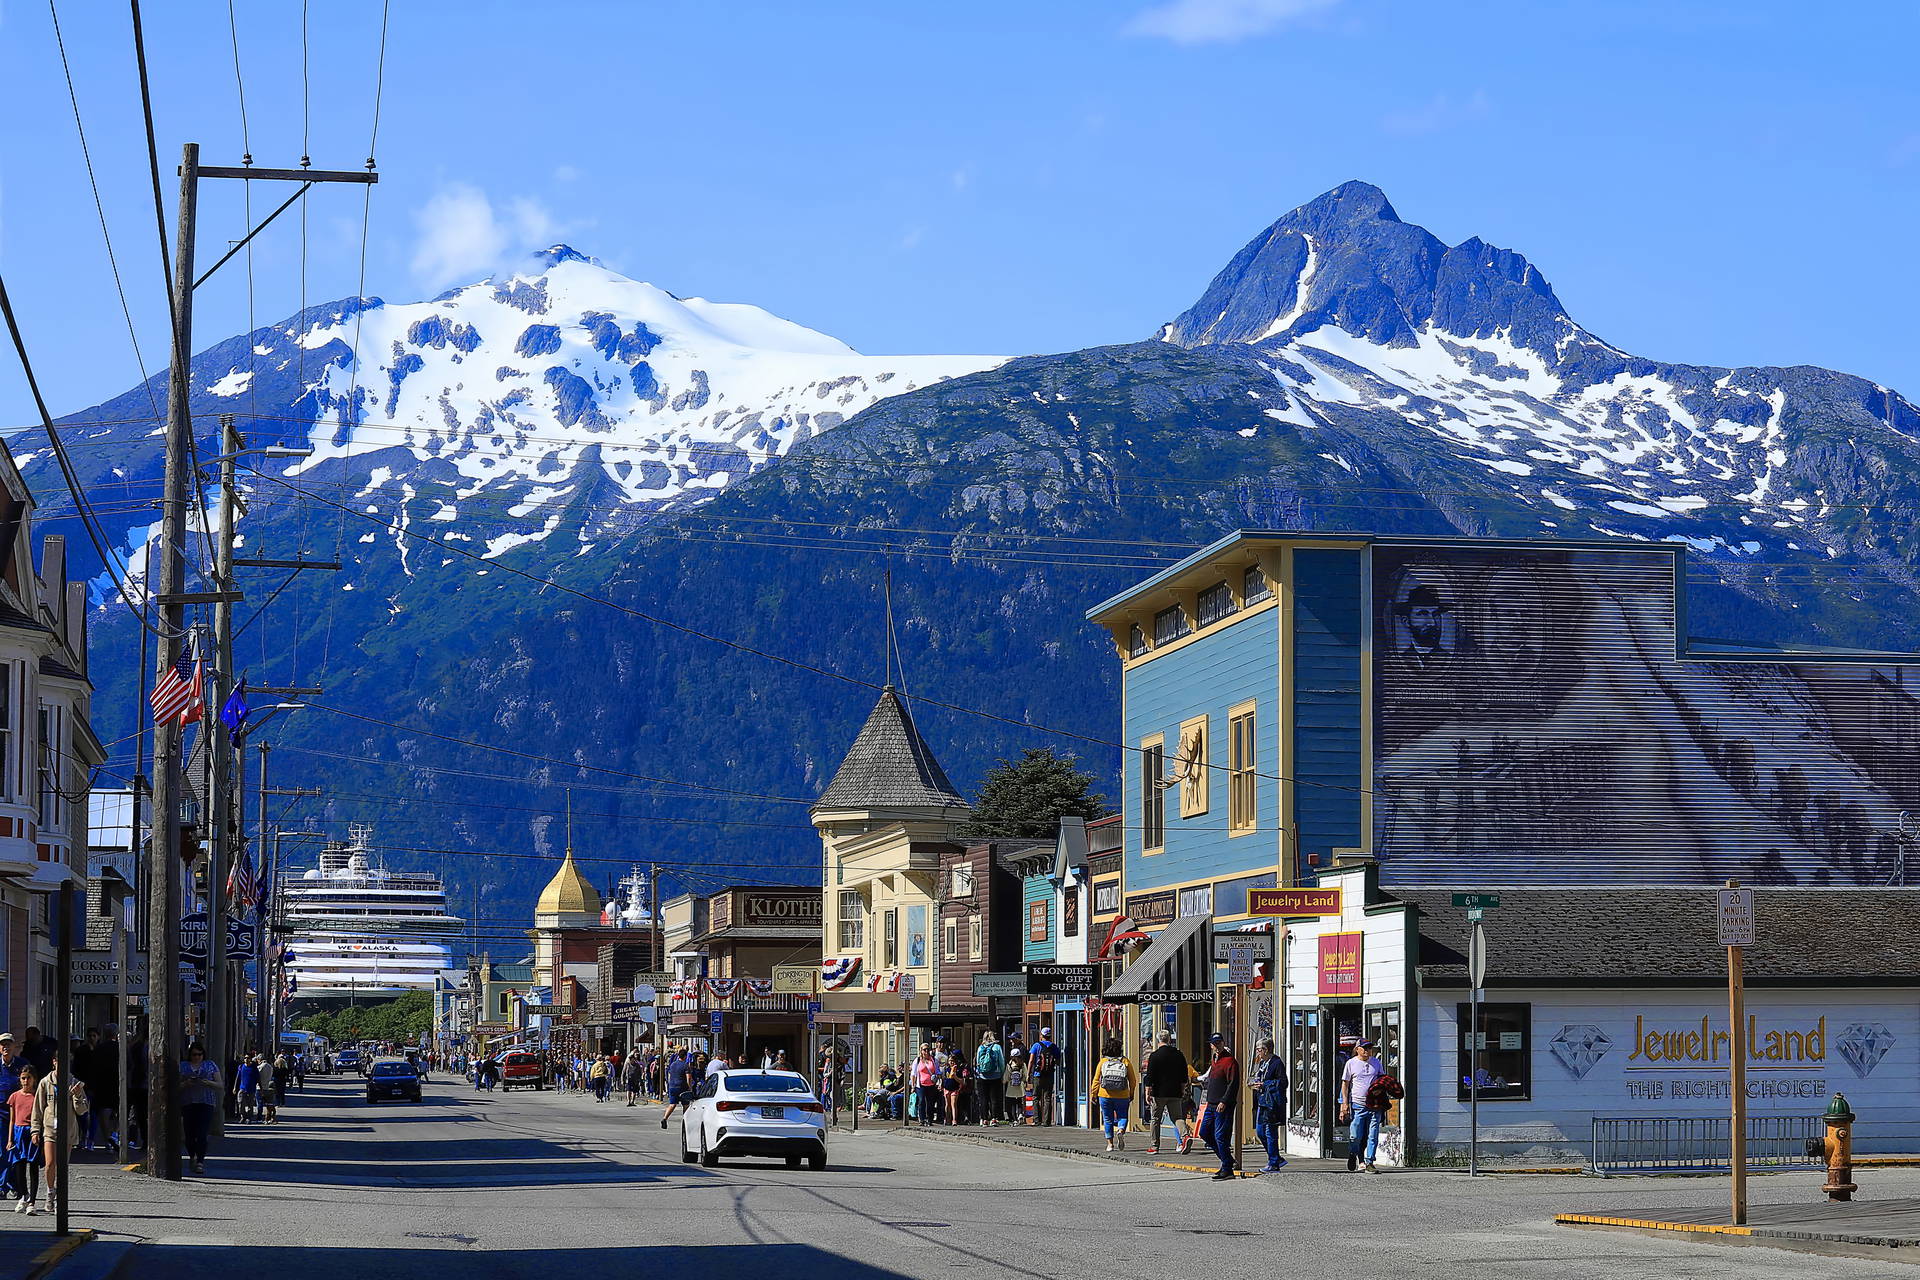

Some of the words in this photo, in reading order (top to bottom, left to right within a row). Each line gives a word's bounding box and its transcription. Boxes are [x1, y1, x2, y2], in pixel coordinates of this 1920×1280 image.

[1255, 894, 1301, 910] Jewelry
[1304, 894, 1334, 906] Land
[1465, 895, 1479, 906] 6TH
[1730, 895, 1740, 904] 20
[750, 898, 823, 917] KLOTHE
[1128, 903, 1144, 919] HOUSE
[1143, 902, 1151, 918] OF
[1722, 917, 1750, 926] PARKING
[1343, 946, 1356, 965] Land
[137, 961, 146, 971] &
[1032, 967, 1093, 975] KLONDIKE
[112, 974, 143, 985] PNS
[1000, 980, 1022, 988] ALASKAN
[1065, 975, 1093, 983] GIFT
[1051, 983, 1092, 991] SUPPLY
[1137, 993, 1167, 1001] FOOD
[1169, 993, 1178, 1001] &
[1180, 992, 1213, 1001] DRINK
[534, 1006, 571, 1014] PANTHEON
[1628, 1014, 1731, 1062] Jewelr
[1749, 1014, 1826, 1061] Land
[1626, 1080, 1664, 1099] THE
[1671, 1080, 1733, 1099] RIGHT
[1744, 1079, 1826, 1099] CHOICE
